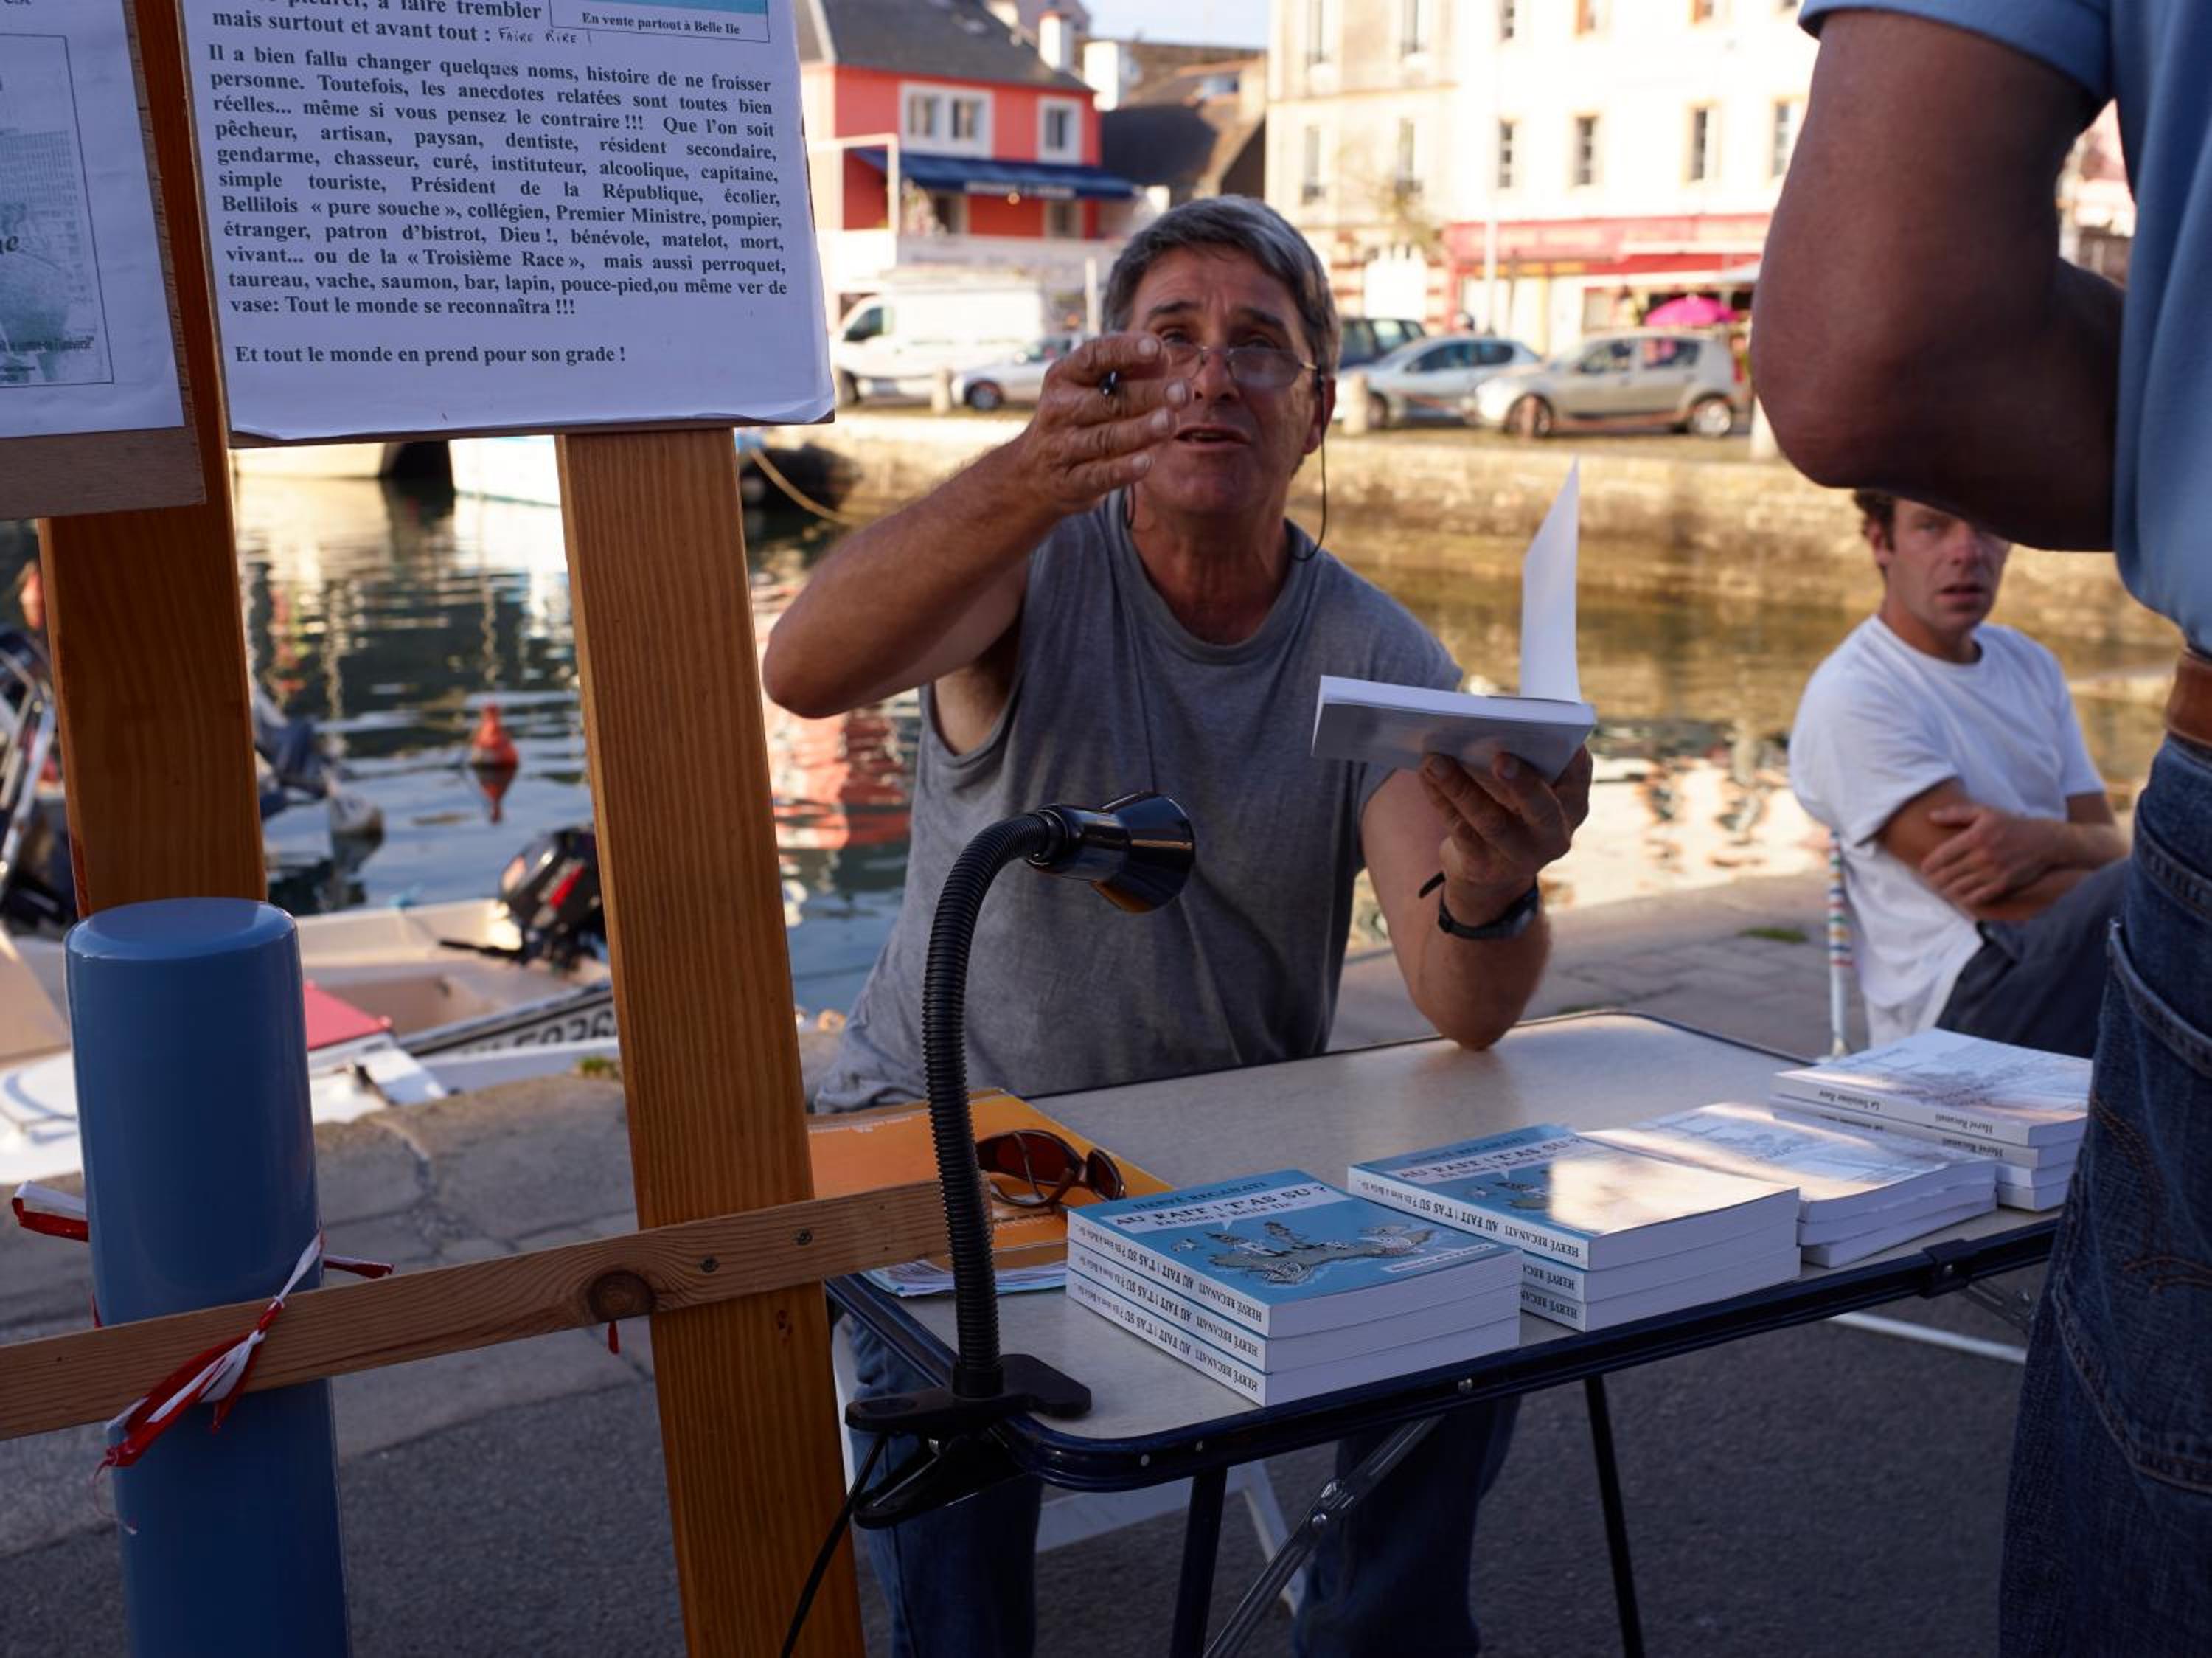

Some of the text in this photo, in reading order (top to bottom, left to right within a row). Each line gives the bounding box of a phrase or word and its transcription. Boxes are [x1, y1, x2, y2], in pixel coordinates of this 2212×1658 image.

[456, 0, 543, 20] trembler
[212, 9, 479, 42] mais surtout et avant tout
[582, 11, 740, 35] En vente partout à Belle Ile
[208, 44, 772, 93] Il a bien fallu changer quelques noms, histoire de ne froisser
[210, 73, 773, 115] personne. Toutefois, les anecdotes relatées sont toutes bien
[213, 94, 292, 114] réelles...
[302, 98, 360, 117] même
[369, 101, 385, 118] si
[394, 107, 437, 121] vous
[447, 109, 507, 126] pensez
[515, 108, 532, 125] le
[662, 116, 698, 135] Que
[745, 122, 774, 138] soit
[214, 119, 777, 163] pêcheur, artisan, paysan, dentiste, résident secondaire,
[216, 145, 779, 185] gendarme, chasseur, curé, instituteur, alcoolique, capitaine,
[218, 170, 781, 208] simple touriste, Président de la République, écolier,
[221, 195, 299, 213] Bellilois
[467, 204, 551, 223] collégien,
[555, 204, 626, 223] Premier
[630, 207, 707, 228] Ministre,
[711, 211, 782, 231] pompier,
[223, 220, 311, 243] étranger,
[324, 223, 388, 243] patron
[570, 228, 650, 249] bénévole,
[661, 232, 729, 251] matelot,
[740, 236, 785, 253] mort,
[225, 245, 305, 263] vivant...
[313, 251, 338, 264] ou
[347, 247, 371, 264] de
[380, 247, 398, 265] la
[603, 253, 644, 269] mais
[651, 254, 693, 271] aussi
[701, 258, 786, 277] perroquet,
[228, 272, 310, 291] taureau,
[315, 271, 376, 291] vache,
[380, 276, 459, 293] saumon,
[463, 274, 500, 294] bar,
[504, 274, 555, 296] lapin,
[684, 277, 733, 294] même
[737, 282, 765, 295] ver
[768, 279, 787, 295] de
[229, 299, 279, 313] vase:
[283, 295, 330, 313] Tout
[333, 296, 351, 313] le
[355, 297, 420, 313] monde
[423, 301, 442, 314] se
[235, 345, 259, 363] Et
[263, 347, 303, 363] tout
[307, 345, 324, 363] le
[330, 346, 393, 363] monde
[397, 350, 420, 362] en
[424, 345, 479, 367] prend
[483, 349, 527, 367] pour
[531, 350, 561, 362] son
[1155, 1206, 1206, 1219] FAIT
[1281, 1187, 1312, 1200] SU
[1419, 1198, 1432, 1211] SU
[1461, 1211, 1483, 1229] FAIT
[1485, 1219, 1500, 1233] AU
[1504, 1224, 1550, 1249] RECANATI
[1127, 1247, 1138, 1262] SU
[1161, 1264, 1180, 1284] FAIT
[1181, 1274, 1195, 1290] AU
[1125, 1279, 1136, 1293] SU
[1124, 1308, 1135, 1325] SU
[1160, 1296, 1179, 1317] FAIT
[1180, 1307, 1192, 1322] AU
[1159, 1328, 1178, 1348] FAIT
[1179, 1340, 1192, 1356] AU
